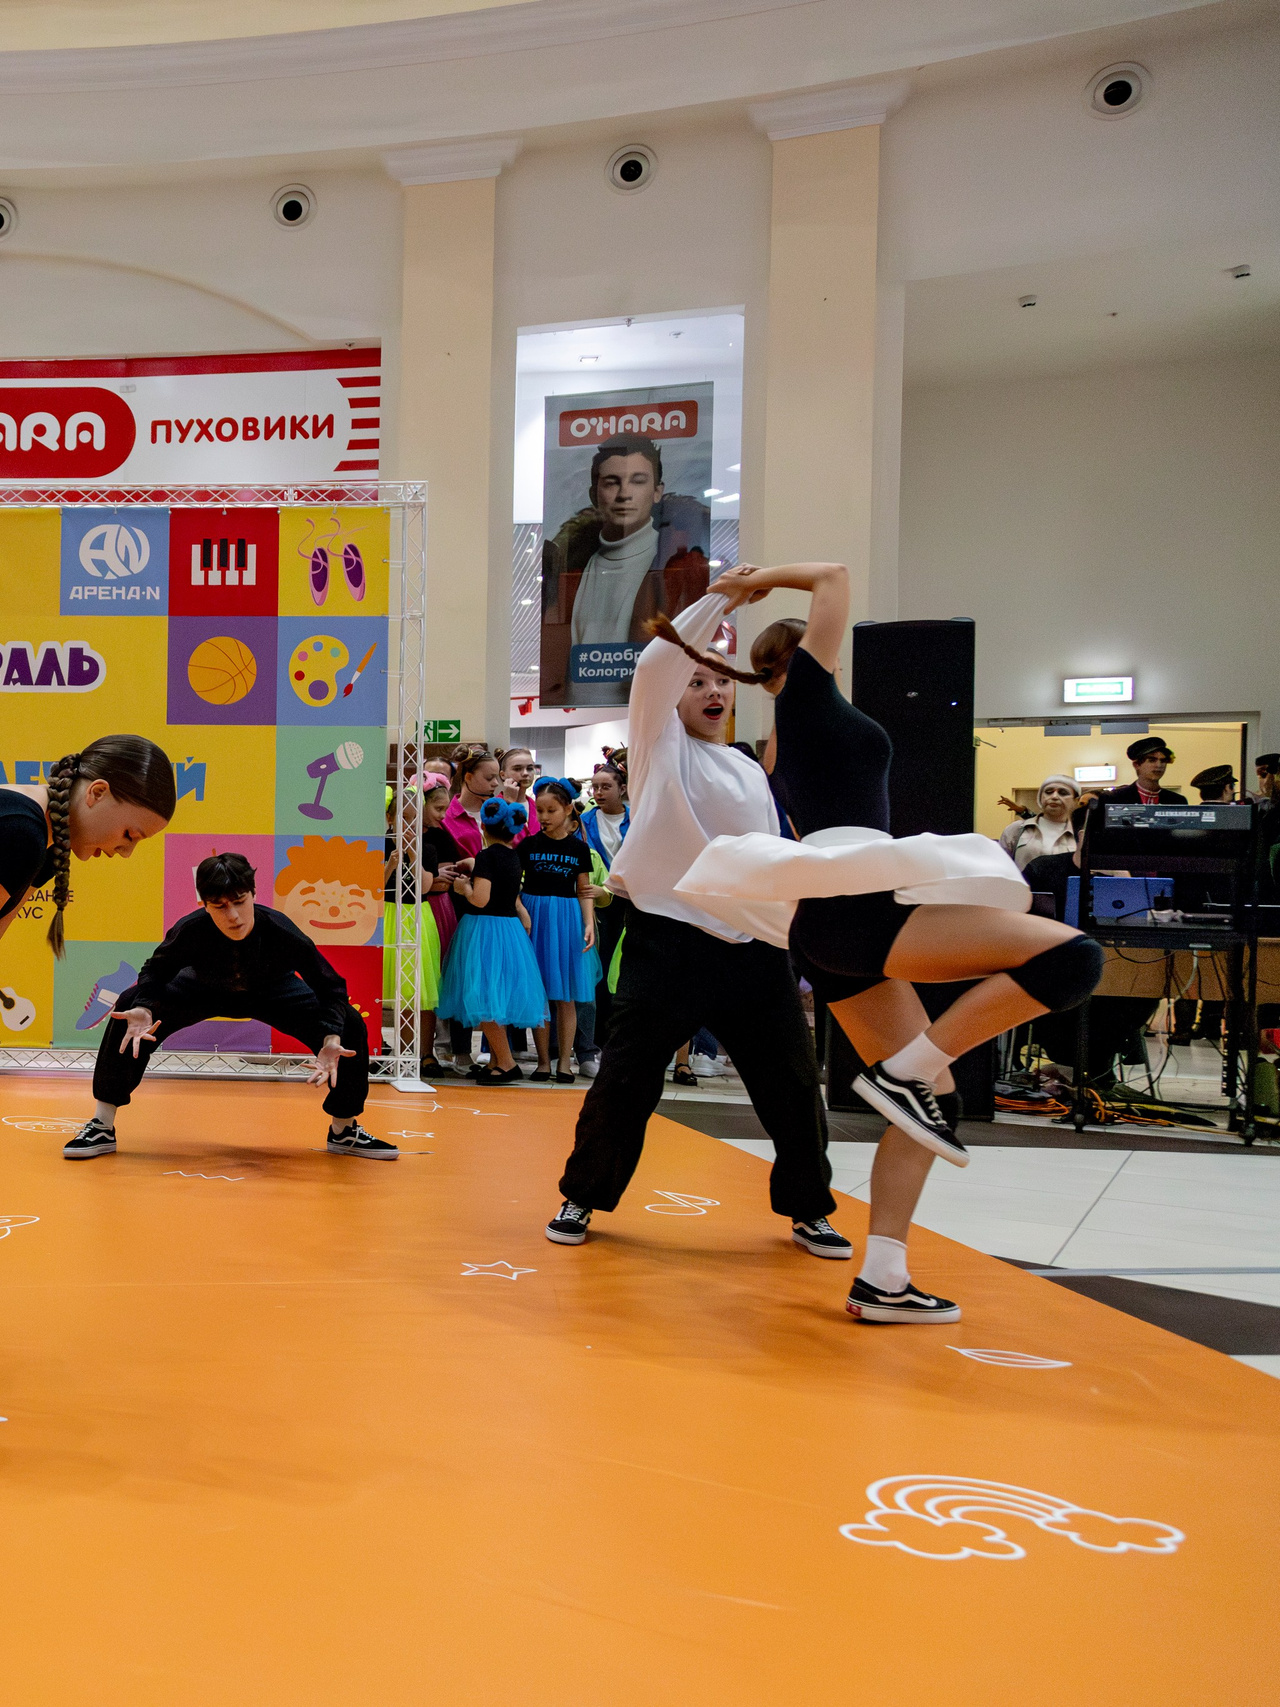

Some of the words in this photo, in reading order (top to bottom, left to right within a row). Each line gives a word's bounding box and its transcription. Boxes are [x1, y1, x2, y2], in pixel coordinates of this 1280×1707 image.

[150, 413, 335, 445] ПУХОВИКИ
[570, 409, 687, 438] O'HARA
[578, 648, 642, 664] #Одобр
[578, 666, 636, 678] Кологри
[529, 852, 580, 866] BEAUTIFUL
